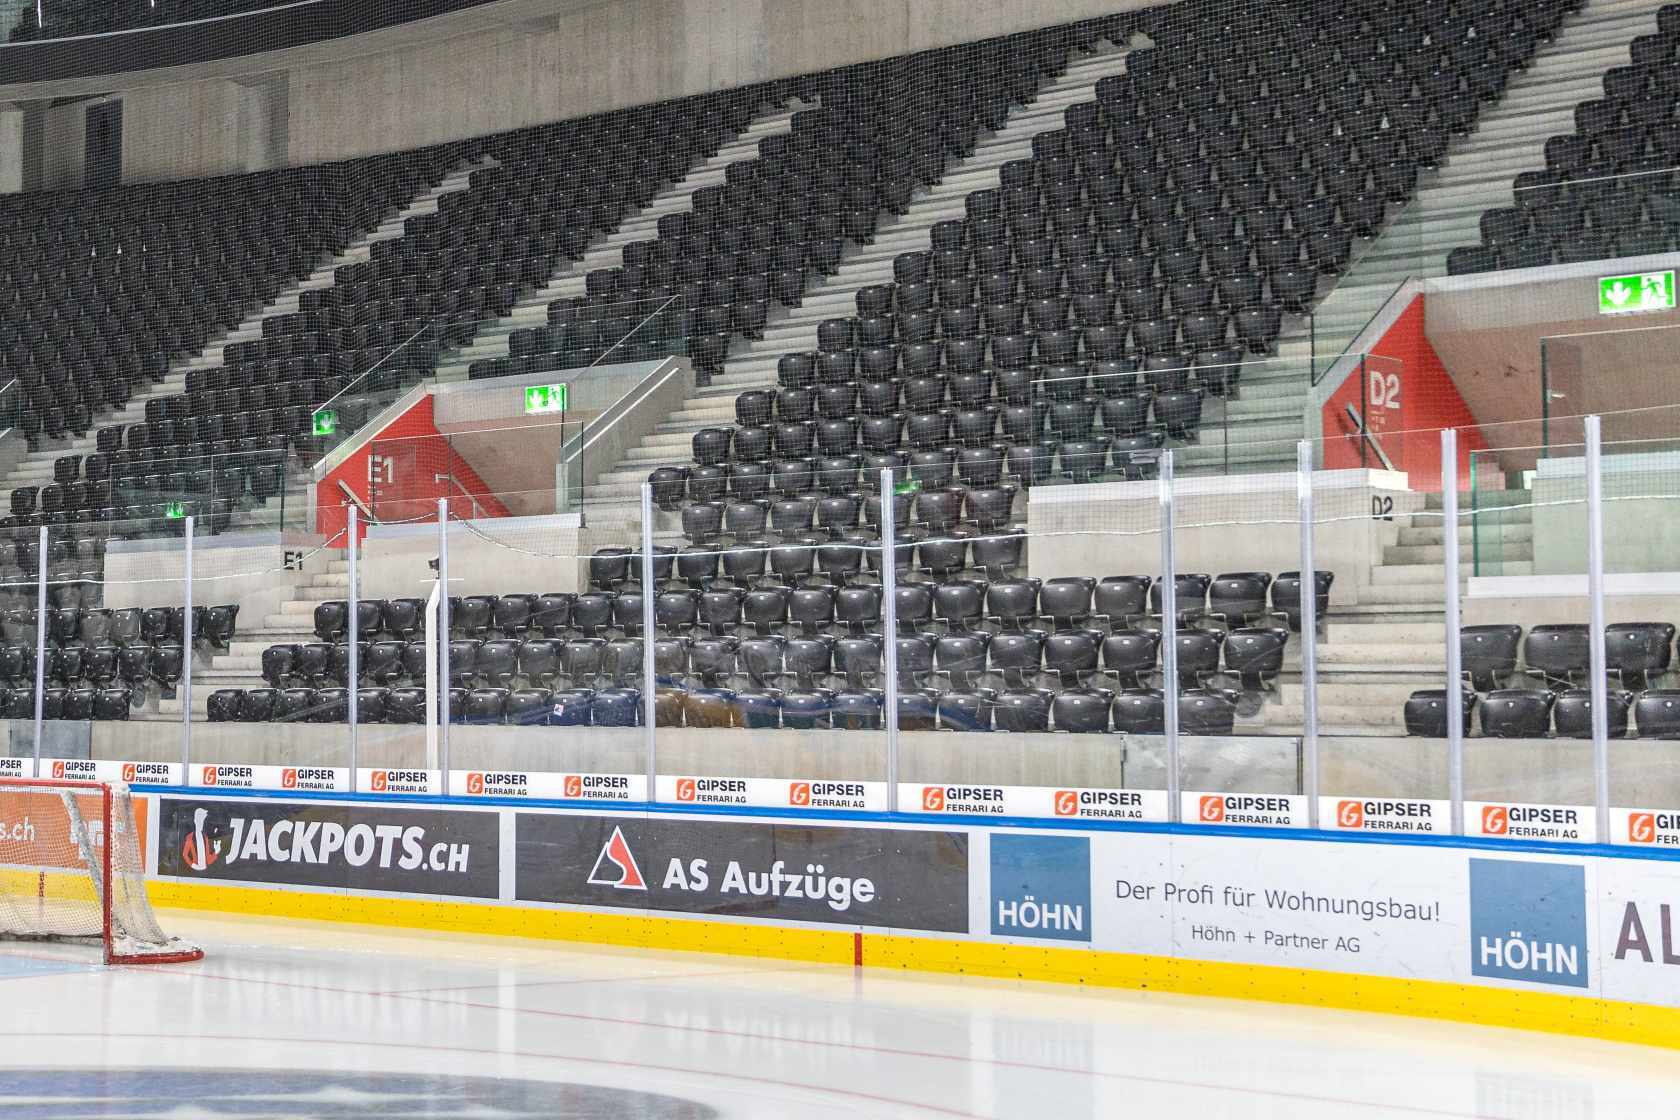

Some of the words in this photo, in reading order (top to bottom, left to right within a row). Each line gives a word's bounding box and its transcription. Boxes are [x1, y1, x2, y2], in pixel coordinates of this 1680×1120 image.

[1370, 370, 1401, 409] D2
[367, 454, 394, 484] E1
[1372, 495, 1393, 521] D2
[283, 551, 303, 570] E1
[66, 761, 95, 772] GIPSER
[137, 764, 168, 774] GIPSER
[218, 767, 252, 778] GIPSER
[298, 769, 334, 781] GIPSER
[388, 771, 427, 783] GIPSER
[485, 774, 526, 786] GIPSER
[326, 782, 334, 790] AG
[583, 776, 628, 789] GIPSER
[697, 779, 745, 792] GIPSER
[485, 788, 515, 796] FERRARI
[583, 791, 615, 799] FERRARI
[812, 783, 864, 796] GIPSER
[947, 787, 1003, 802] GIPSER
[697, 795, 732, 803] FERRARI
[812, 799, 849, 808] FERRARI
[853, 800, 864, 808] AG
[1081, 791, 1141, 807] GIPSER
[1225, 797, 1289, 812] GIPSER
[947, 804, 987, 813] FERRARI
[991, 805, 1003, 814] AG
[1081, 808, 1125, 818] FERRARI
[1128, 809, 1141, 819] AG
[1364, 801, 1431, 818] GIPSER
[1509, 807, 1577, 824] GIPSER
[1225, 814, 1272, 824] FERRARI
[1276, 816, 1290, 825] AG
[1364, 820, 1413, 831] FERRARI
[1417, 822, 1432, 831] AG
[1509, 827, 1558, 839] FERRARI
[1563, 829, 1577, 839] AG
[225, 817, 470, 873] JACKPOTS.CH
[662, 858, 709, 892] AS
[720, 860, 876, 911] Aufzüge
[1115, 880, 1156, 901] Der
[1164, 882, 1214, 905] Profi
[1224, 886, 1257, 908] für
[1265, 889, 1441, 923] Wohnungsbau!
[998, 895, 1083, 931] HÖHN
[1192, 925, 1236, 943] Höhn
[1264, 930, 1329, 951] Partner
[1334, 935, 1361, 953] AG
[1480, 931, 1578, 976] HÖHN
